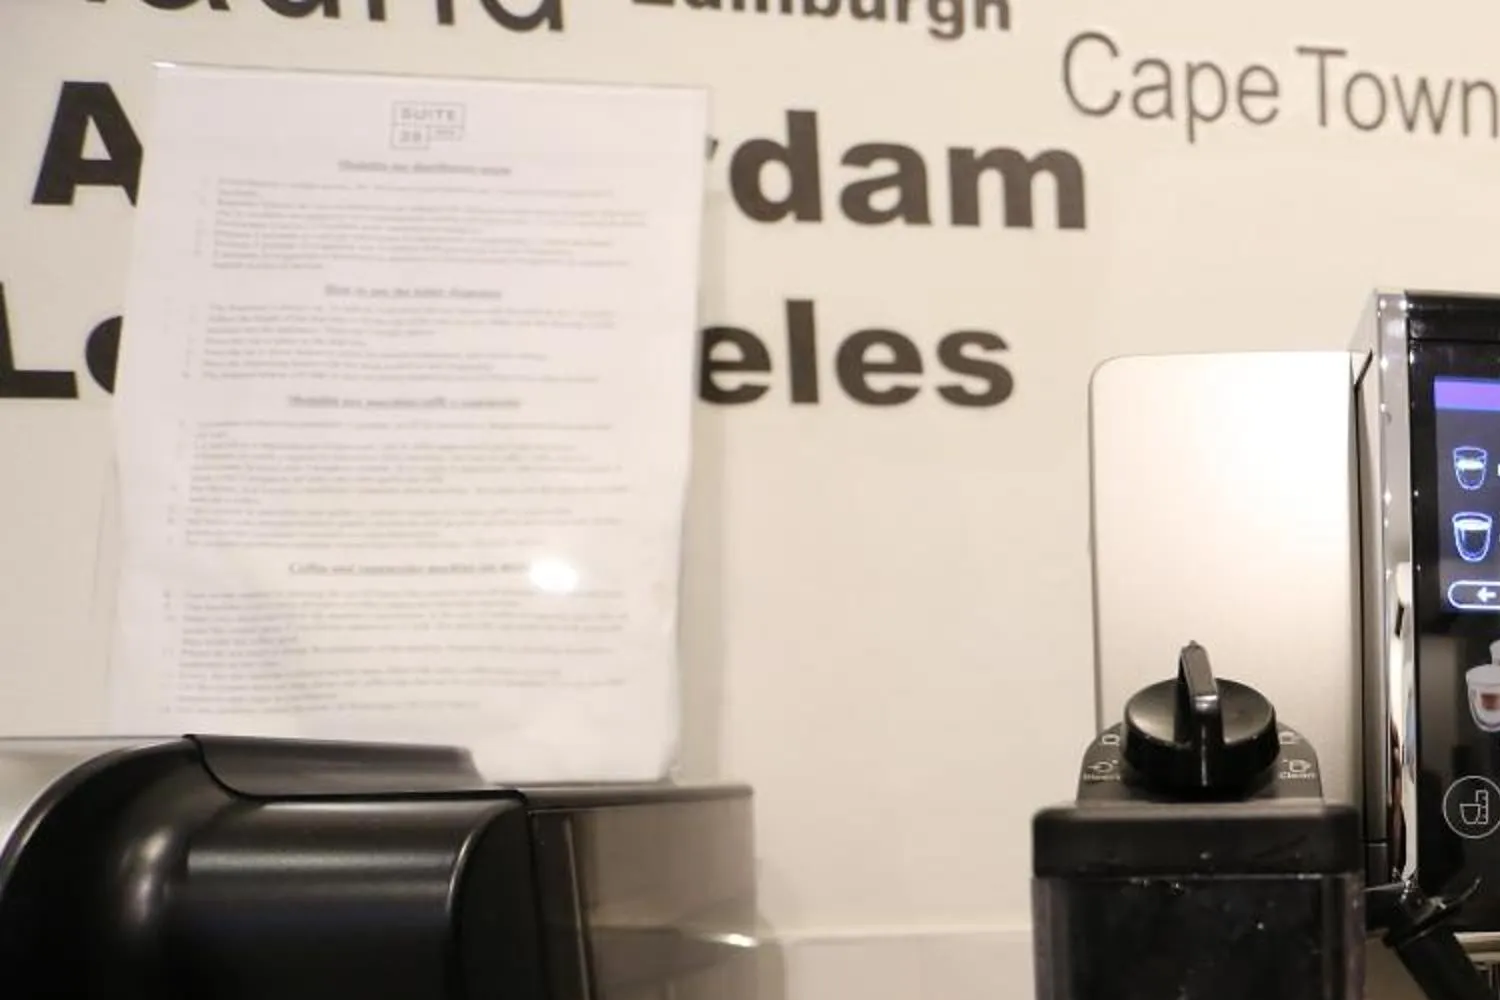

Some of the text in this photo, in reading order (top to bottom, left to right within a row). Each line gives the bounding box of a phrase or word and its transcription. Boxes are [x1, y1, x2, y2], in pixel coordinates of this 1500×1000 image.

[1062, 31, 1499, 143] Cape Town
[696, 298, 1015, 407] eles
